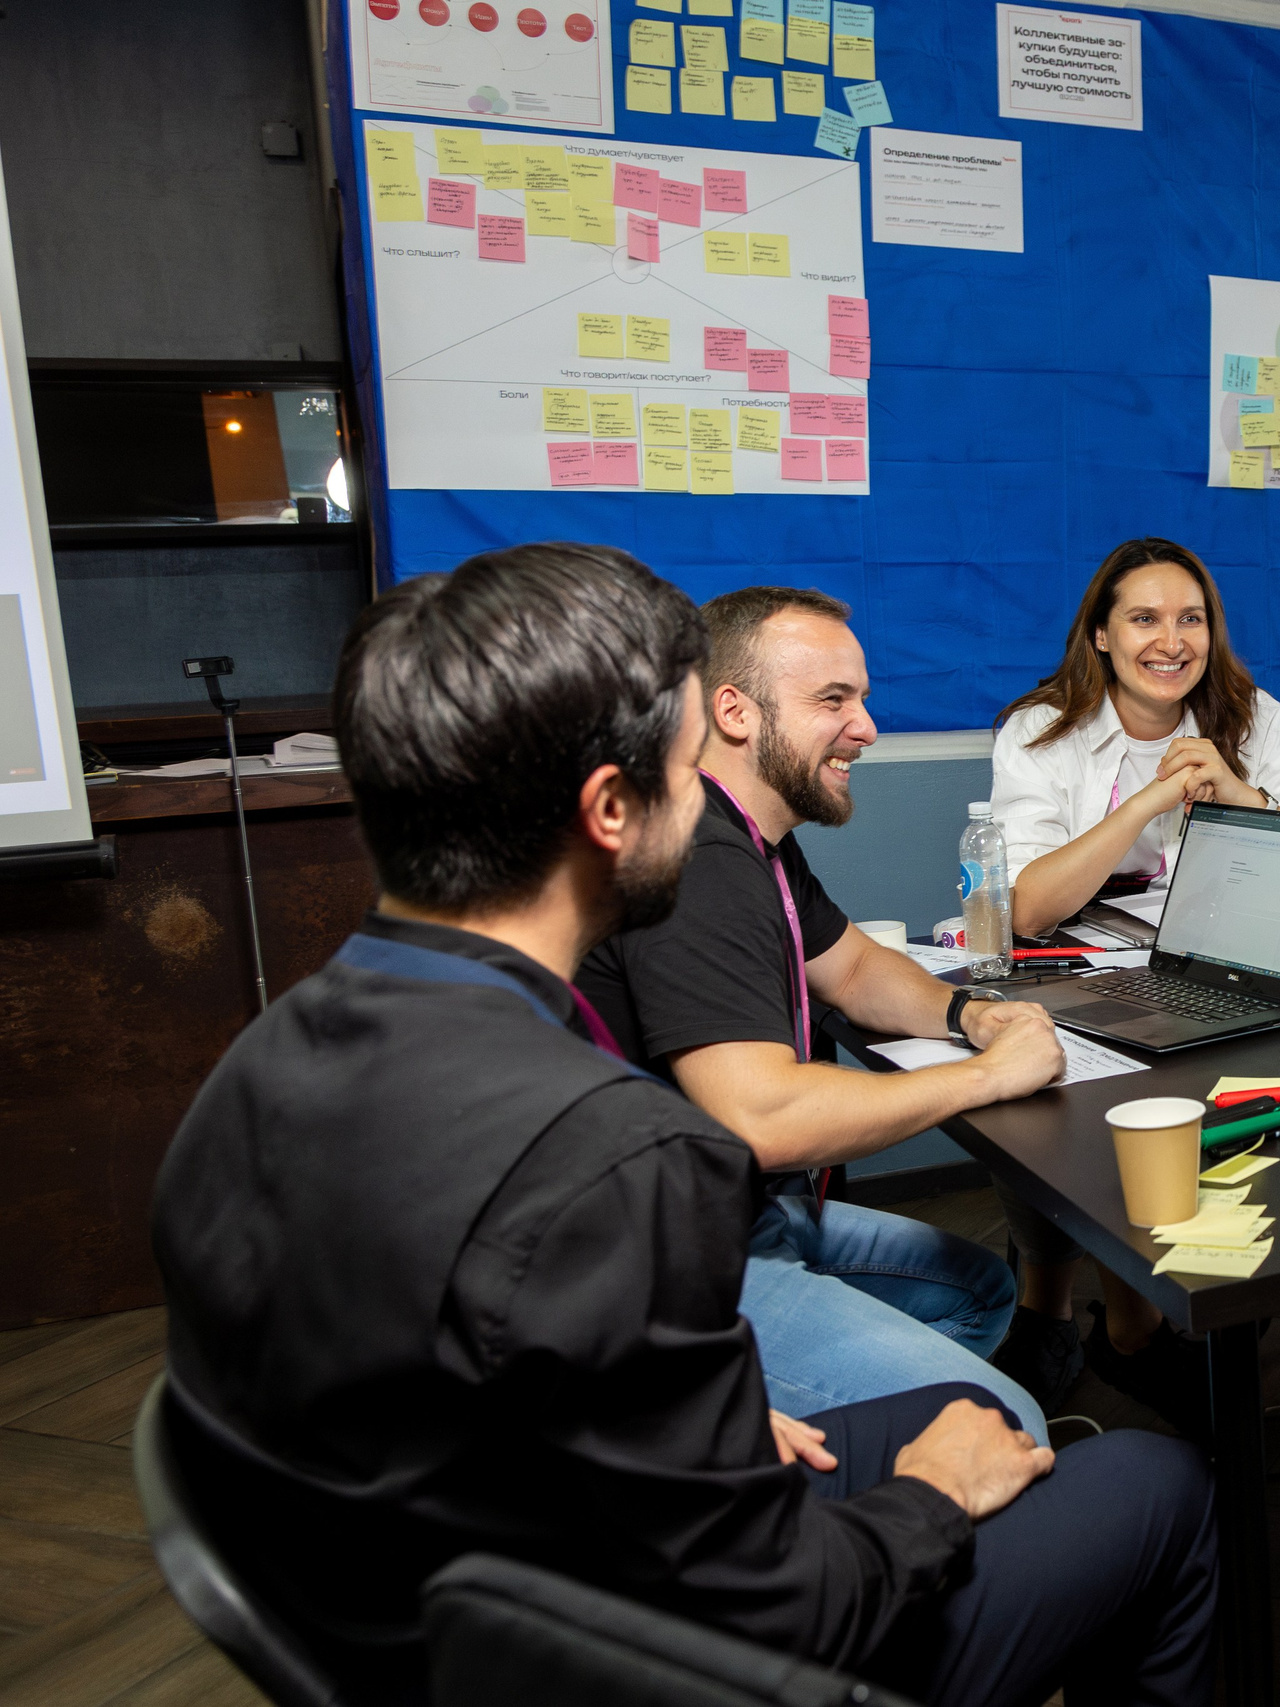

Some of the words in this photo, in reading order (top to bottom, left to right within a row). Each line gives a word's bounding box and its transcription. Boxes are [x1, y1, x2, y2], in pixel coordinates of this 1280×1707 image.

[1014, 26, 1105, 46] Коллективные
[1018, 41, 1056, 54] купки
[1058, 44, 1122, 61] будущего:
[1025, 54, 1117, 73] объединиться,
[1021, 67, 1061, 79] чтобы
[1063, 71, 1121, 86] получить
[1011, 79, 1064, 94] лучшую
[1066, 86, 1132, 100] стоимость
[564, 145, 586, 154] Что
[588, 147, 685, 163] думает/чувствует
[883, 147, 950, 162] Определение
[952, 155, 1002, 167] проблемы
[383, 247, 404, 256] Что
[407, 248, 460, 259] слышит?
[801, 272, 819, 281] Что
[821, 273, 856, 283] видит?
[560, 369, 582, 379] Что
[583, 370, 649, 382] говорит/как
[650, 374, 711, 385] поступает?
[499, 390, 529, 399] Боли
[721, 398, 790, 409] Потребности
[1228, 973, 1240, 982] DELL
